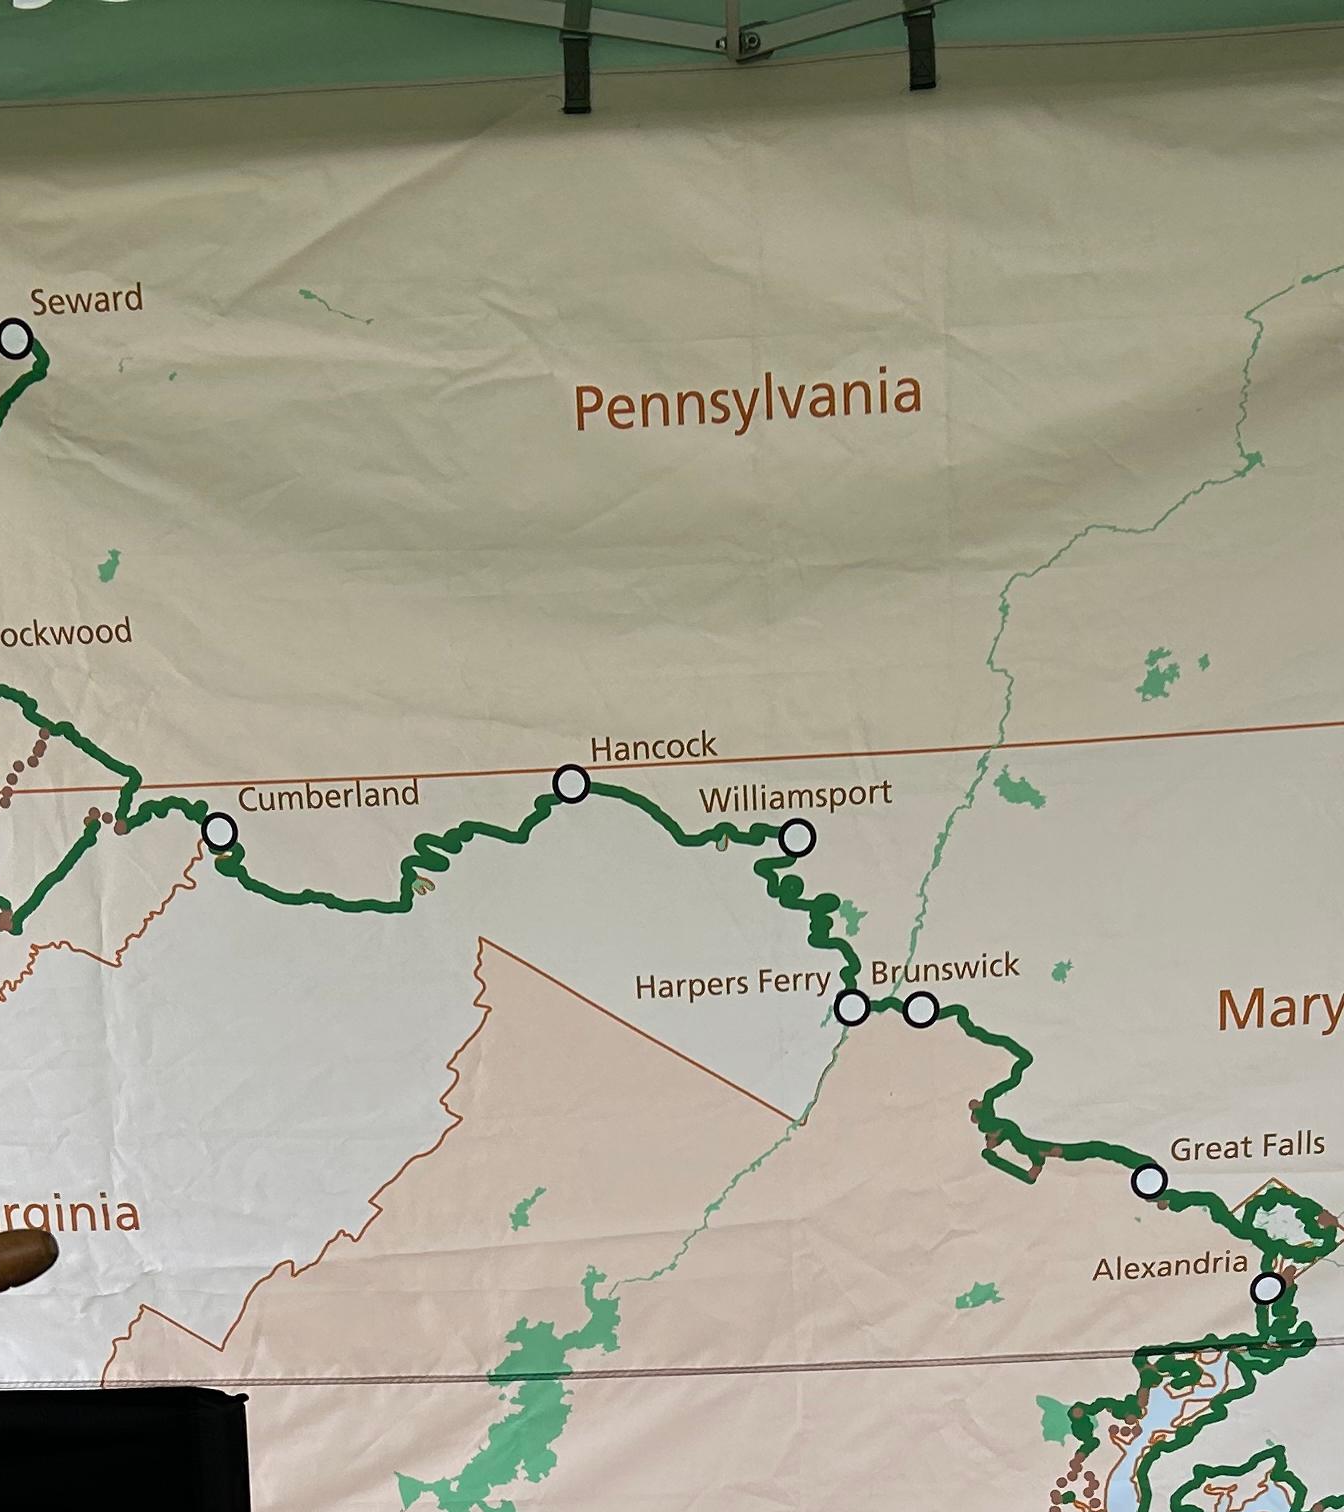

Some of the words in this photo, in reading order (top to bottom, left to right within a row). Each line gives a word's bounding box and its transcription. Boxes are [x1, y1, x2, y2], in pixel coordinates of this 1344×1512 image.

[31, 282, 142, 315] Seward
[575, 366, 921, 436] Pennsylvania
[592, 730, 717, 762] Hancock
[238, 781, 420, 812] Cumberland
[699, 780, 892, 813] Williamsport
[872, 951, 1019, 984] Brunswick
[637, 975, 748, 1003] Harpers
[760, 969, 831, 996] Ferry
[1171, 1136, 1252, 1161] Great
[1264, 1130, 1324, 1156] Falls
[1093, 1250, 1247, 1280] Alexandria
